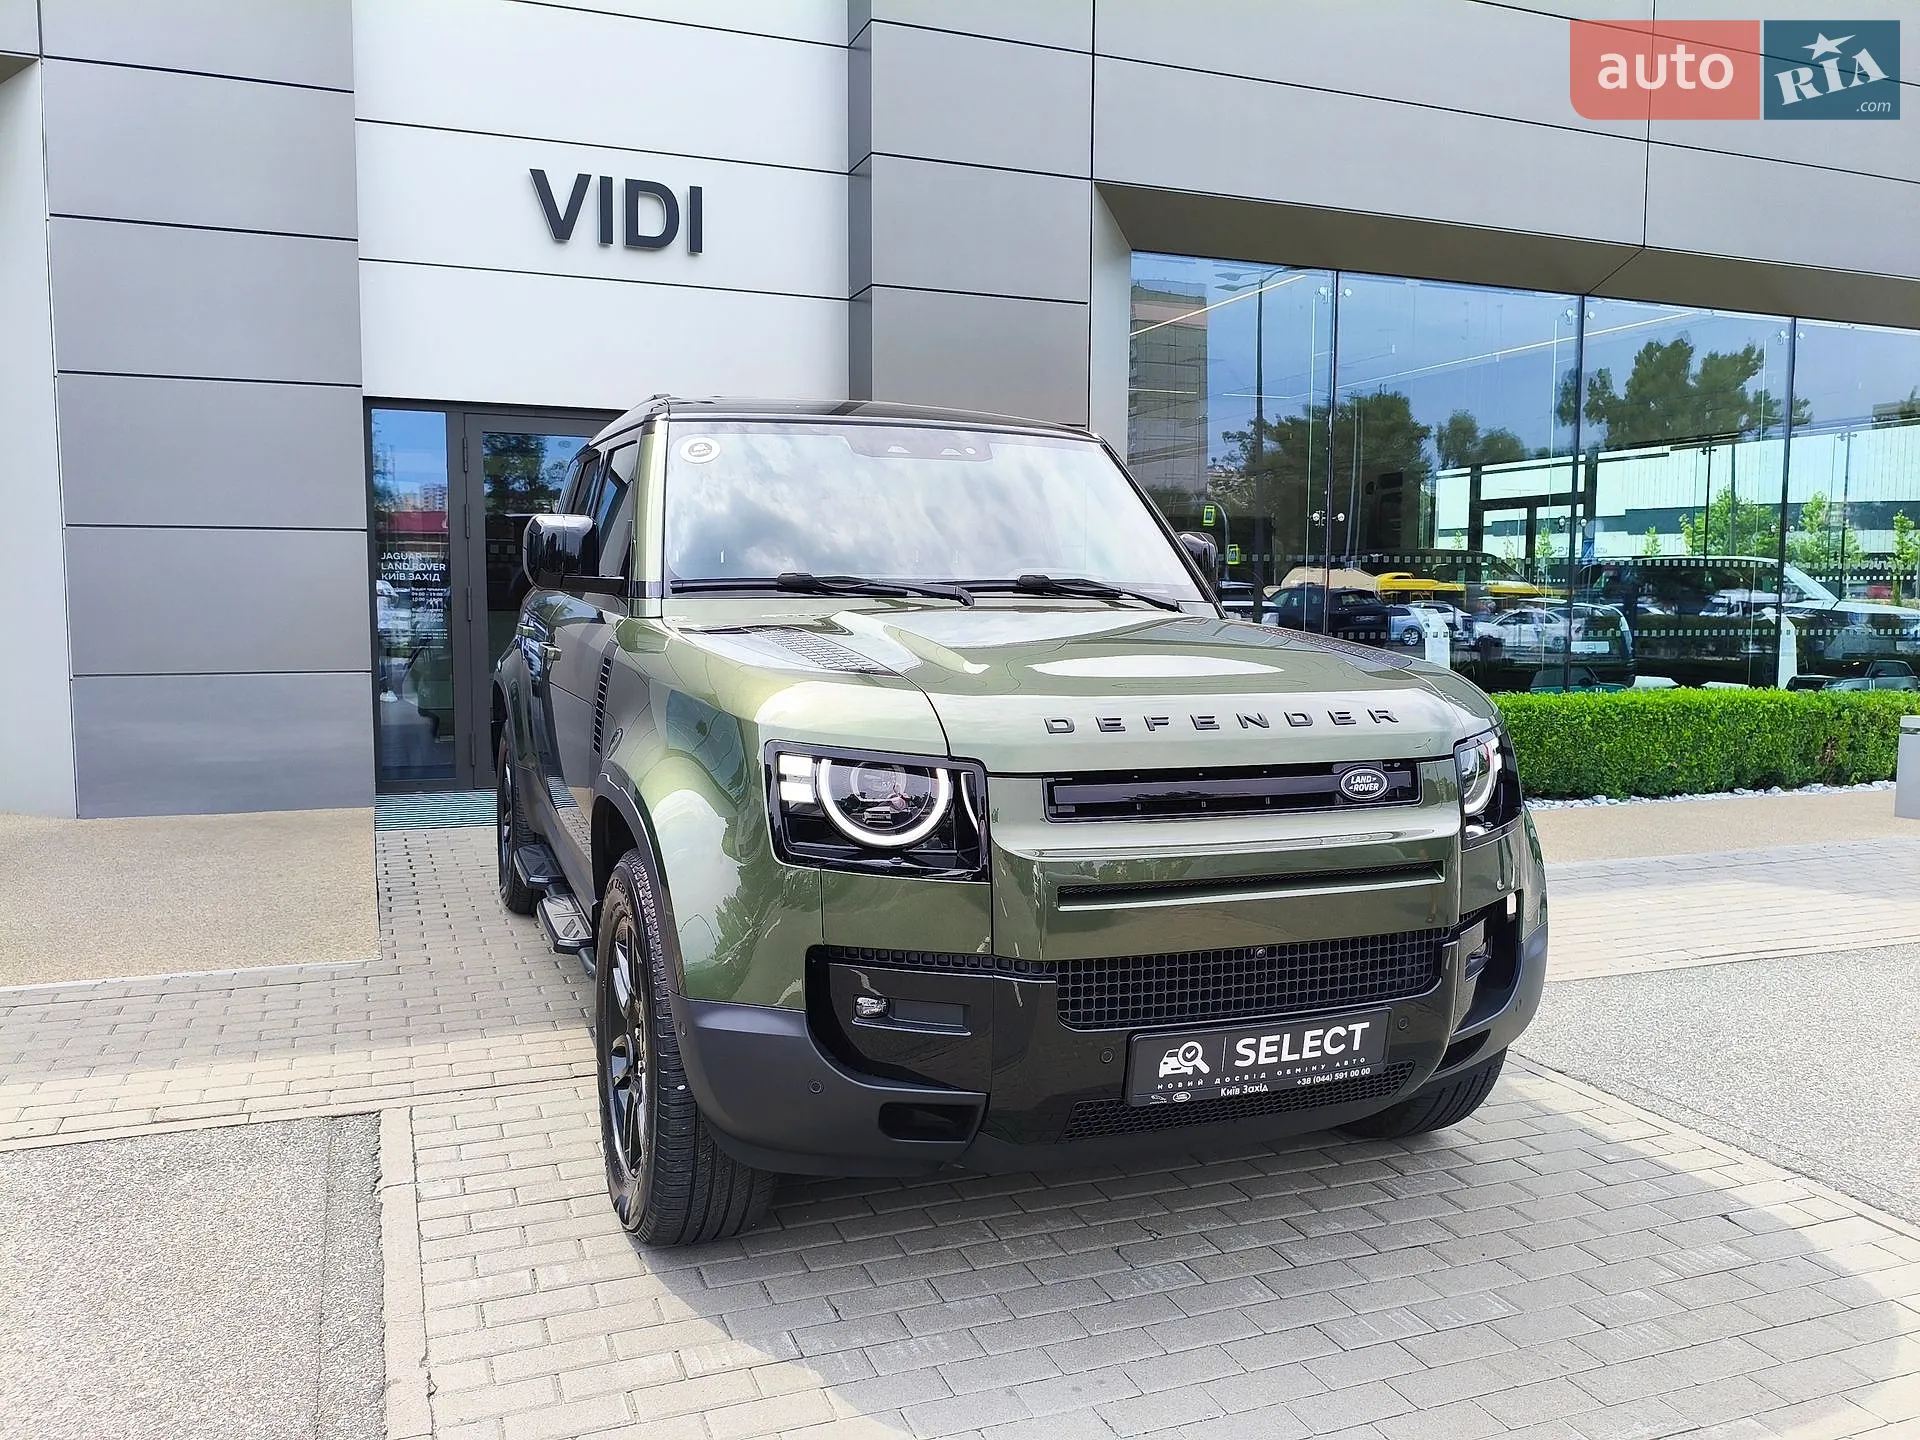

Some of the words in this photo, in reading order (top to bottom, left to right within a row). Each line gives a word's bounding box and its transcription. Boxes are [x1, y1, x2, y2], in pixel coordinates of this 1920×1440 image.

[529, 168, 703, 254] VIDI
[380, 552, 422, 560] JAGUAR
[380, 562, 410, 570] LAND
[412, 562, 446, 571] ROVER
[381, 571, 406, 580] КИЇВ
[408, 573, 441, 582] ЗАХІД
[1044, 708, 1399, 734] DEFENDER
[1351, 775, 1372, 784] LAND
[1353, 783, 1379, 791] ROVER
[1234, 1022, 1370, 1067] SELECT
[1157, 1078, 1204, 1090] НОВИЙ
[1214, 1072, 1266, 1085] ДОСВІД
[1335, 1057, 1366, 1067] АВТО
[1296, 1076, 1312, 1086] +38
[1313, 1073, 1333, 1084] (044)
[1334, 1071, 1348, 1080] 591
[1350, 1068, 1359, 1077] 00
[1360, 1067, 1371, 1076] 00
[1220, 1085, 1240, 1097] Київ
[1242, 1082, 1269, 1094] Захід
